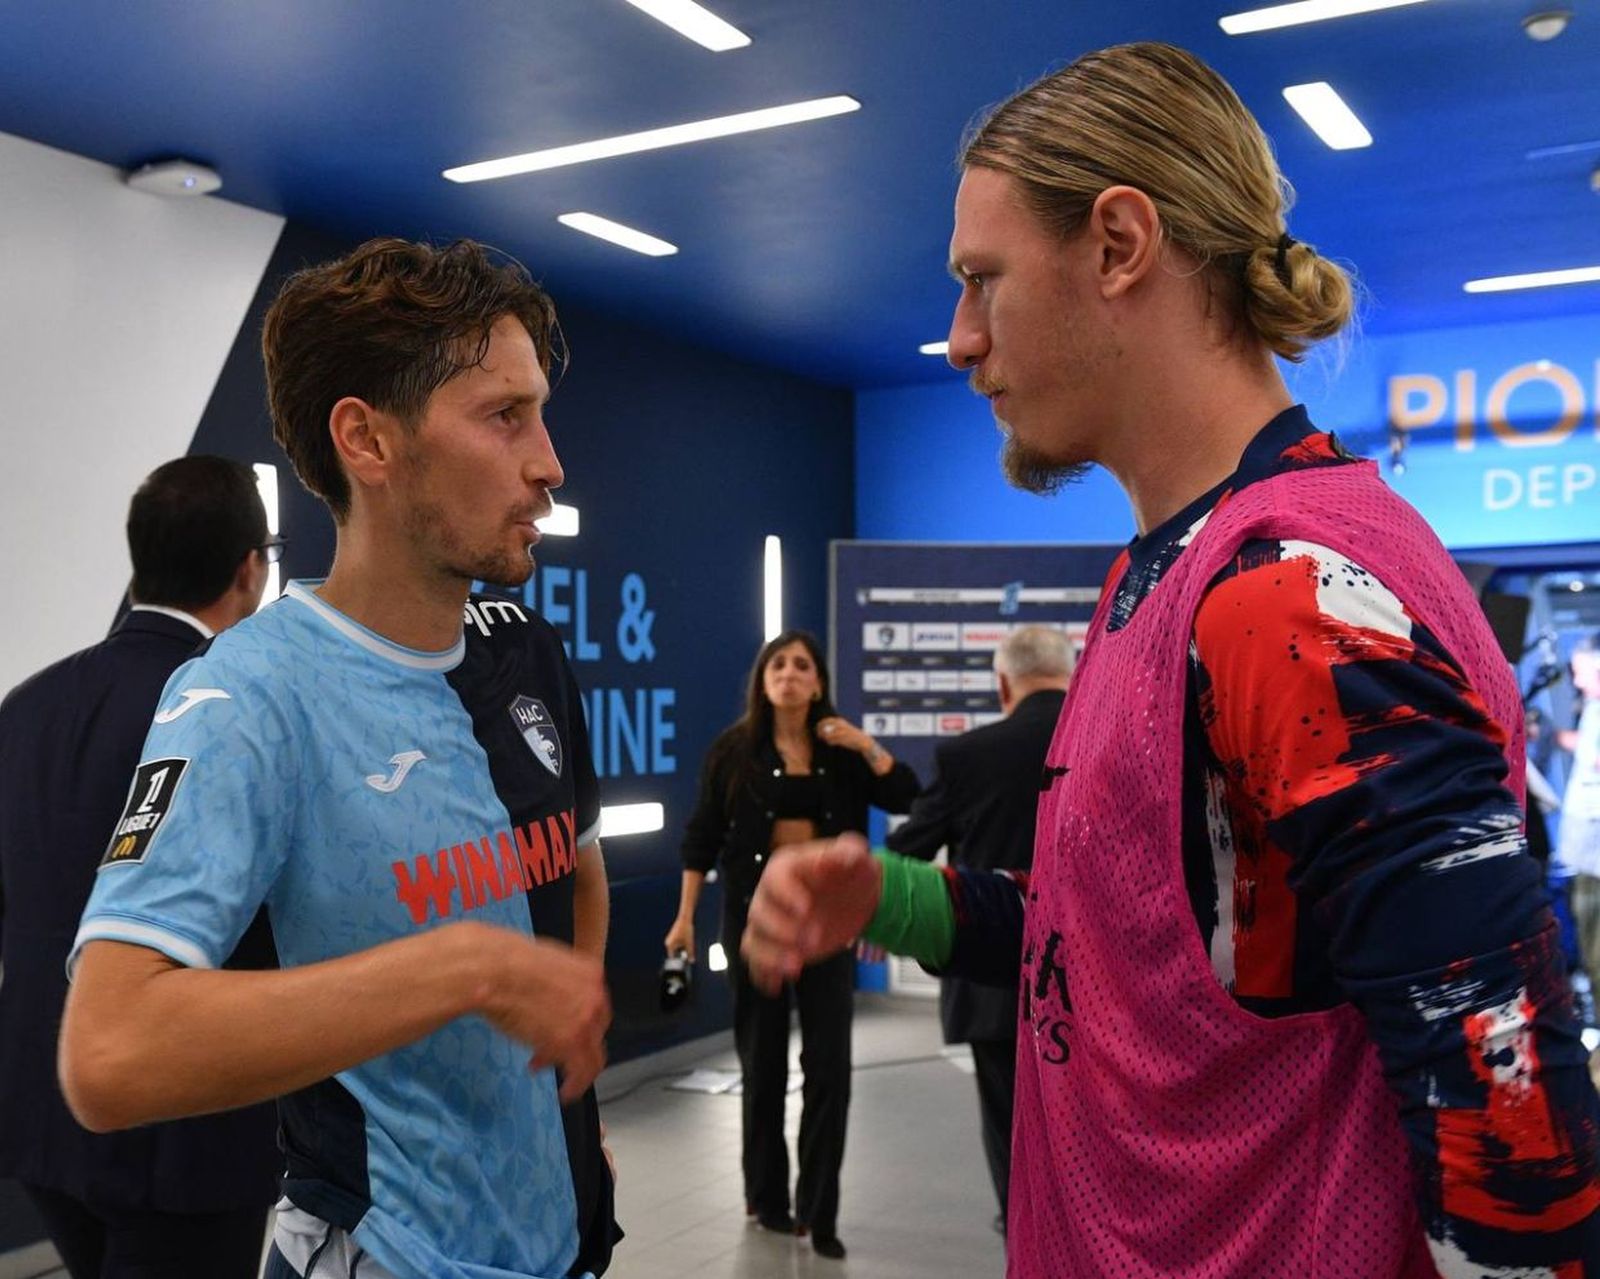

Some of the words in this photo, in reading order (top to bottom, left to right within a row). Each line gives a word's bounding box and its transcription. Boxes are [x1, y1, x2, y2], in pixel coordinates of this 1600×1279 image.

[1389, 361, 1600, 452] PIO
[618, 572, 656, 663] &
[515, 704, 543, 725] HAC
[581, 688, 677, 778] INE
[391, 807, 578, 925] WINAMAX
